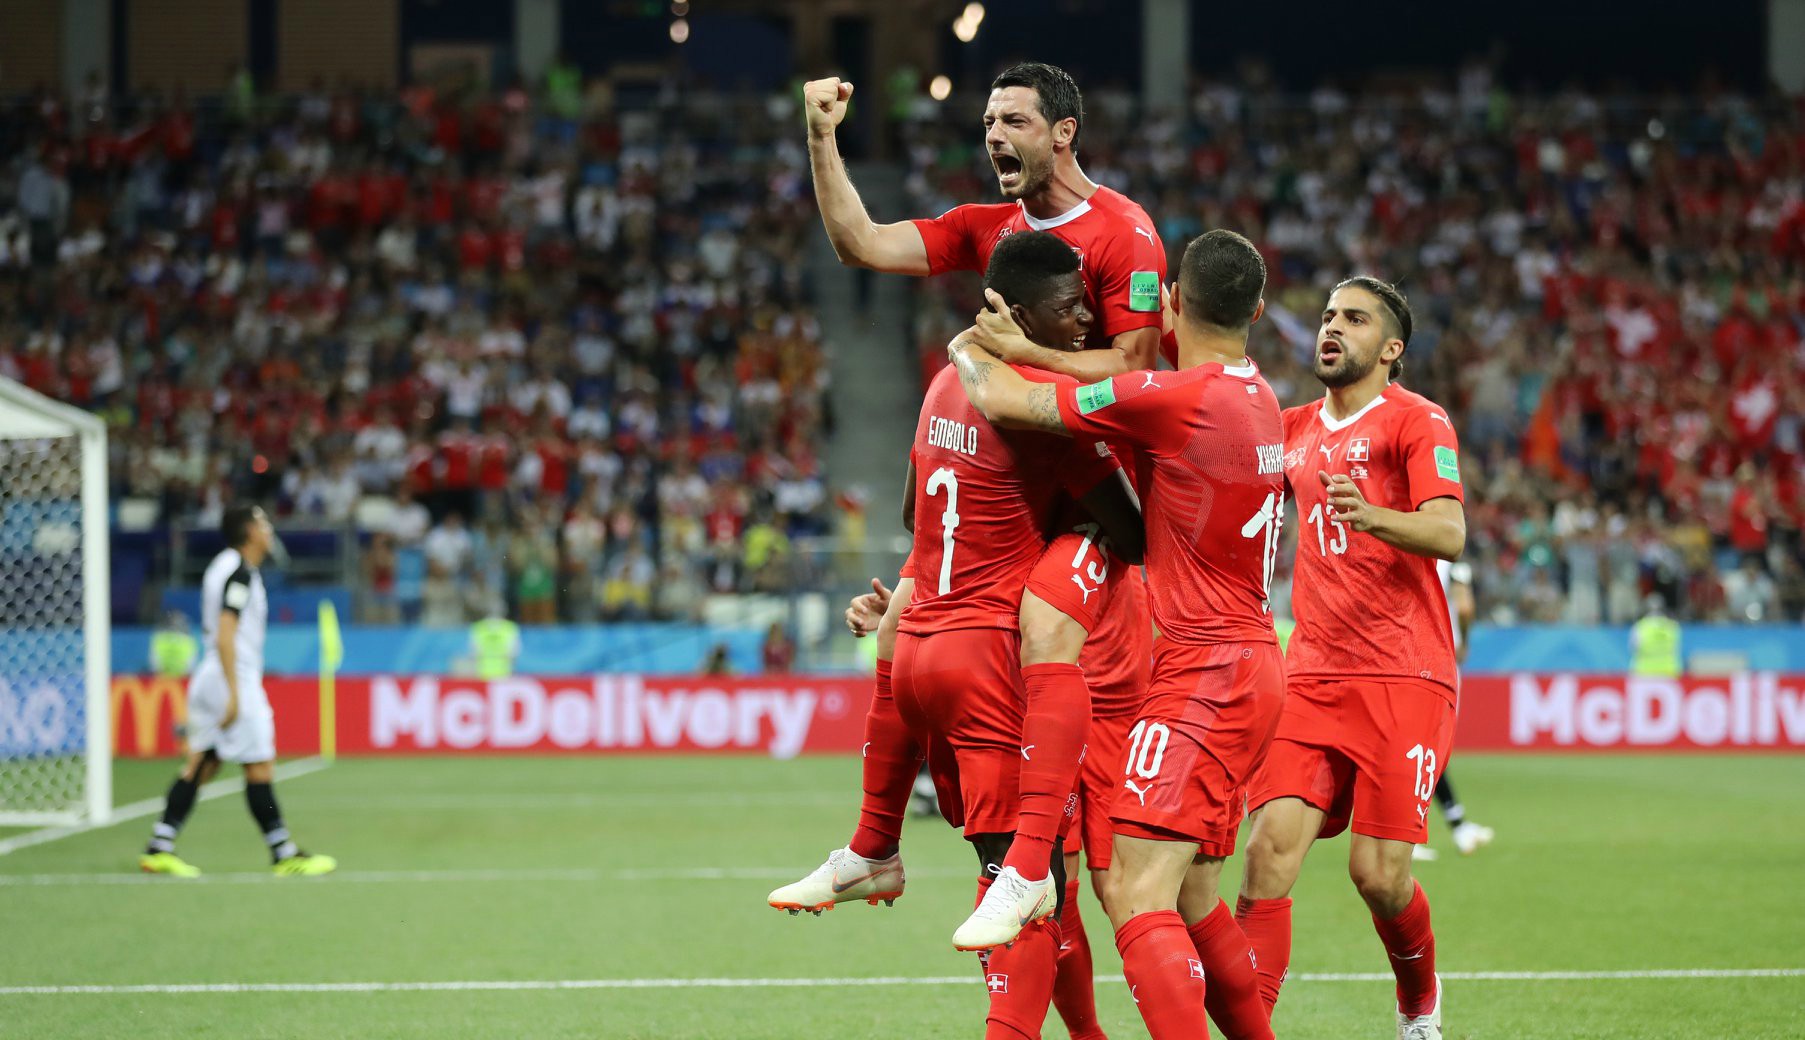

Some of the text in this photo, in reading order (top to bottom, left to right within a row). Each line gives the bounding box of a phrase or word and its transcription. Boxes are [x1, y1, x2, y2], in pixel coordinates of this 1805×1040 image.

[928, 415, 978, 457] EMBOLO
[926, 467, 960, 597] 7
[1307, 502, 1348, 557] 13
[369, 674, 817, 760] McDelivery
[1125, 719, 1170, 780] 10
[1405, 743, 1436, 802] 13
